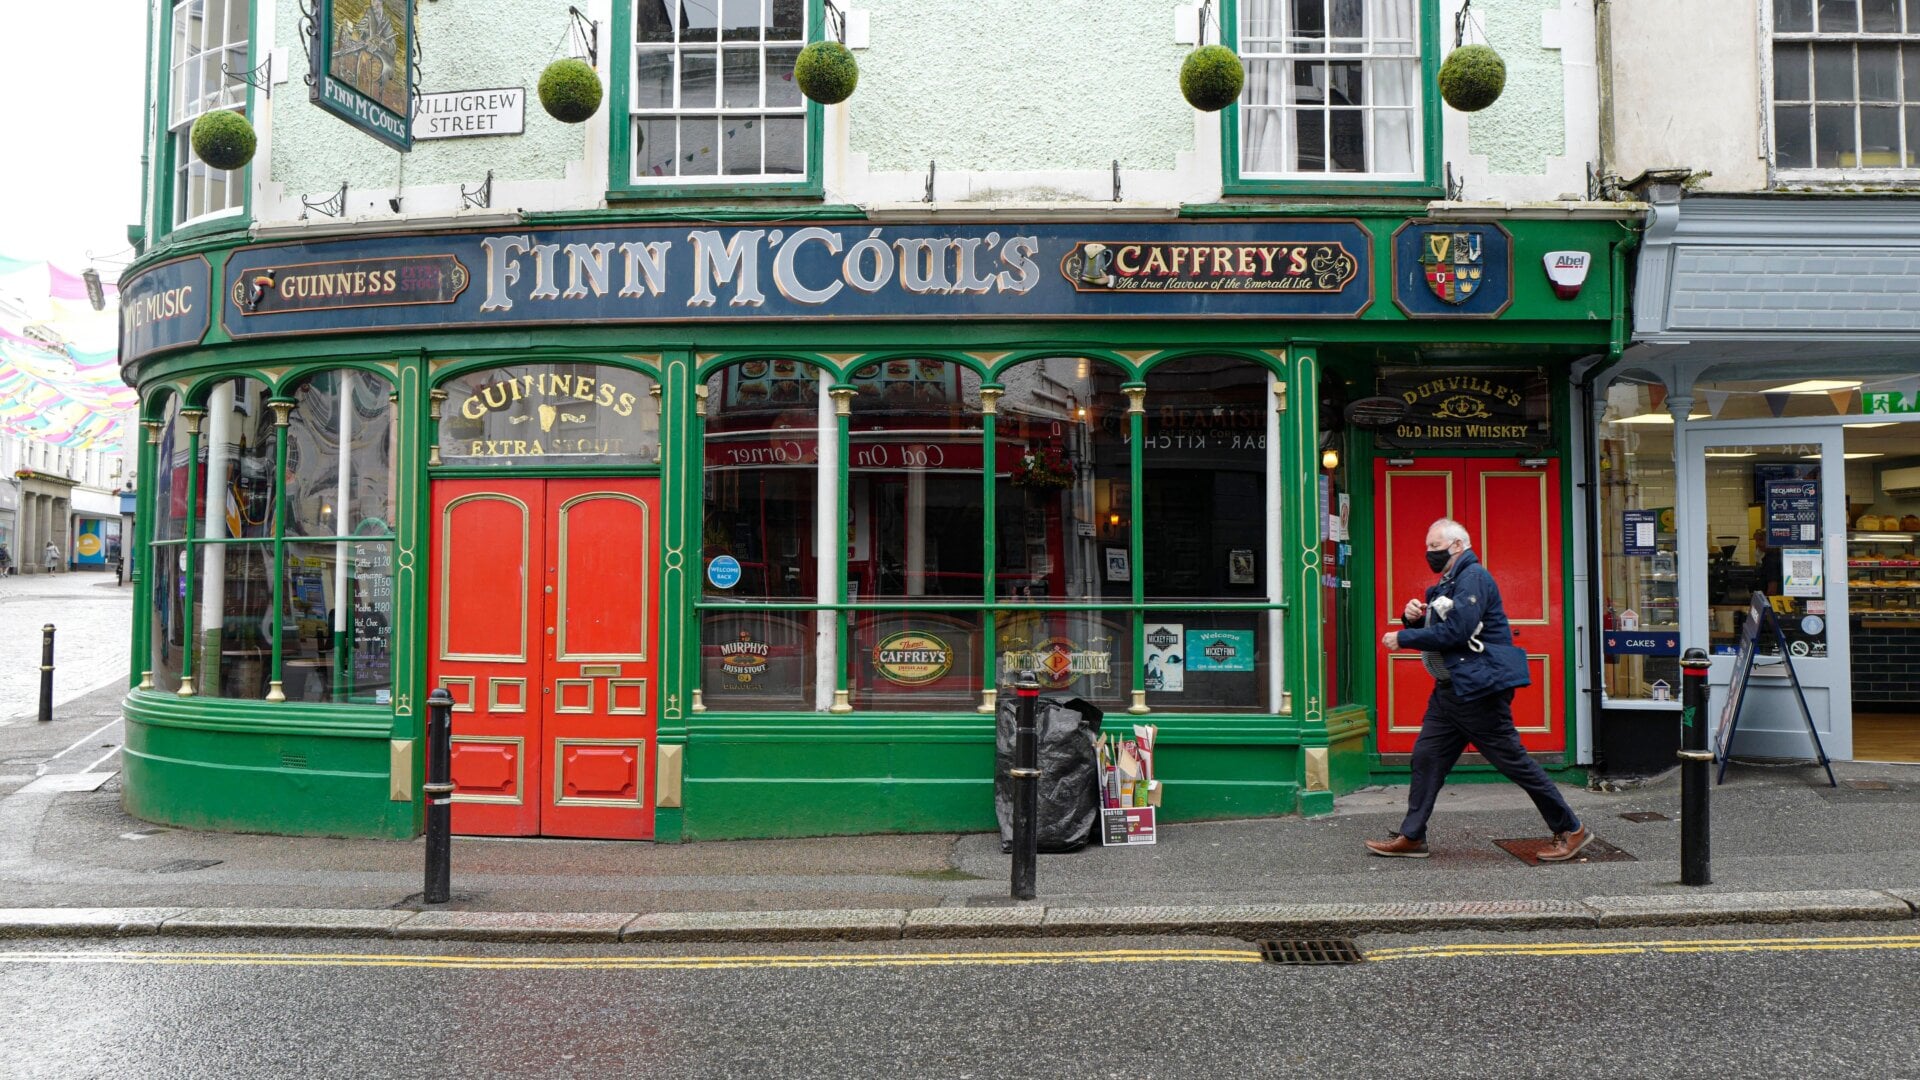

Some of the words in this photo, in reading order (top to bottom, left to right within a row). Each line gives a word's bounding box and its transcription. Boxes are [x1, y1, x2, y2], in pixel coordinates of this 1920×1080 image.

[325, 77, 354, 109] FINN
[414, 93, 517, 115] KILLIGREW
[430, 113, 498, 133] STREET
[1113, 245, 1308, 275] CAFFREY'S
[1556, 256, 1584, 266] Abel
[480, 234, 672, 313] FINN
[281, 269, 396, 299] GUINNESS
[1116, 277, 1138, 289] The
[1141, 277, 1163, 289] true
[1164, 277, 1208, 290] flavour
[1210, 277, 1226, 291] of
[1225, 278, 1241, 289] the
[1244, 277, 1293, 289] Emerald
[1291, 277, 1313, 289] Isle
[146, 285, 192, 323] MUSIC
[462, 373, 636, 420] GUINNESS
[1402, 376, 1522, 407] DUNVILLE'S
[1397, 425, 1422, 438] OLD
[1427, 425, 1462, 438] IRISH
[1466, 425, 1528, 438] WHISKEY
[471, 440, 545, 457] EXTRA
[355, 544, 366, 555] Tea
[1200, 632, 1240, 641] Welcome
[1625, 639, 1656, 648] CAKES
[879, 650, 946, 663] CAFFREY'S
[1053, 657, 1063, 668] P
[1071, 655, 1108, 670] WHISKEY
[723, 663, 743, 673] IRISH
[743, 663, 766, 674] STOUT
